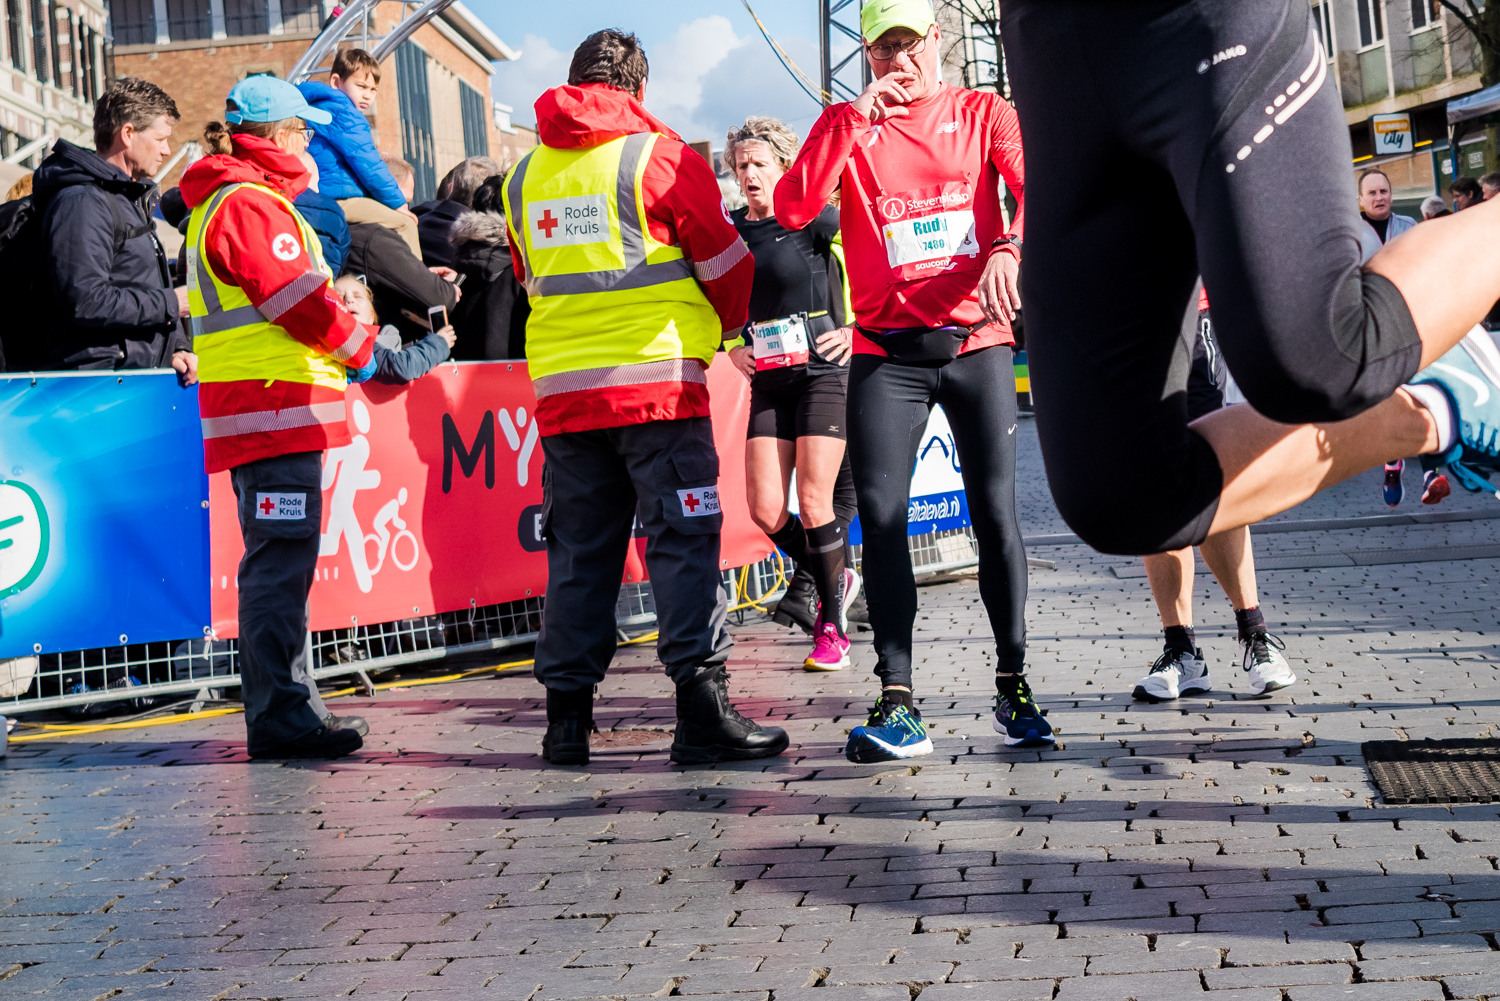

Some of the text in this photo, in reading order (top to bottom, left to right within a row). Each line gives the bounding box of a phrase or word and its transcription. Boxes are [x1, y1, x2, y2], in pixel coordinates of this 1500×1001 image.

[1383, 130, 1405, 149] City
[906, 192, 969, 211] Stevensloop
[564, 205, 598, 220] Rode
[565, 221, 600, 236] Kruis
[913, 217, 948, 235] Rudy
[915, 258, 951, 270] saucony
[280, 497, 302, 506] Rode
[280, 507, 302, 516] Kruis
